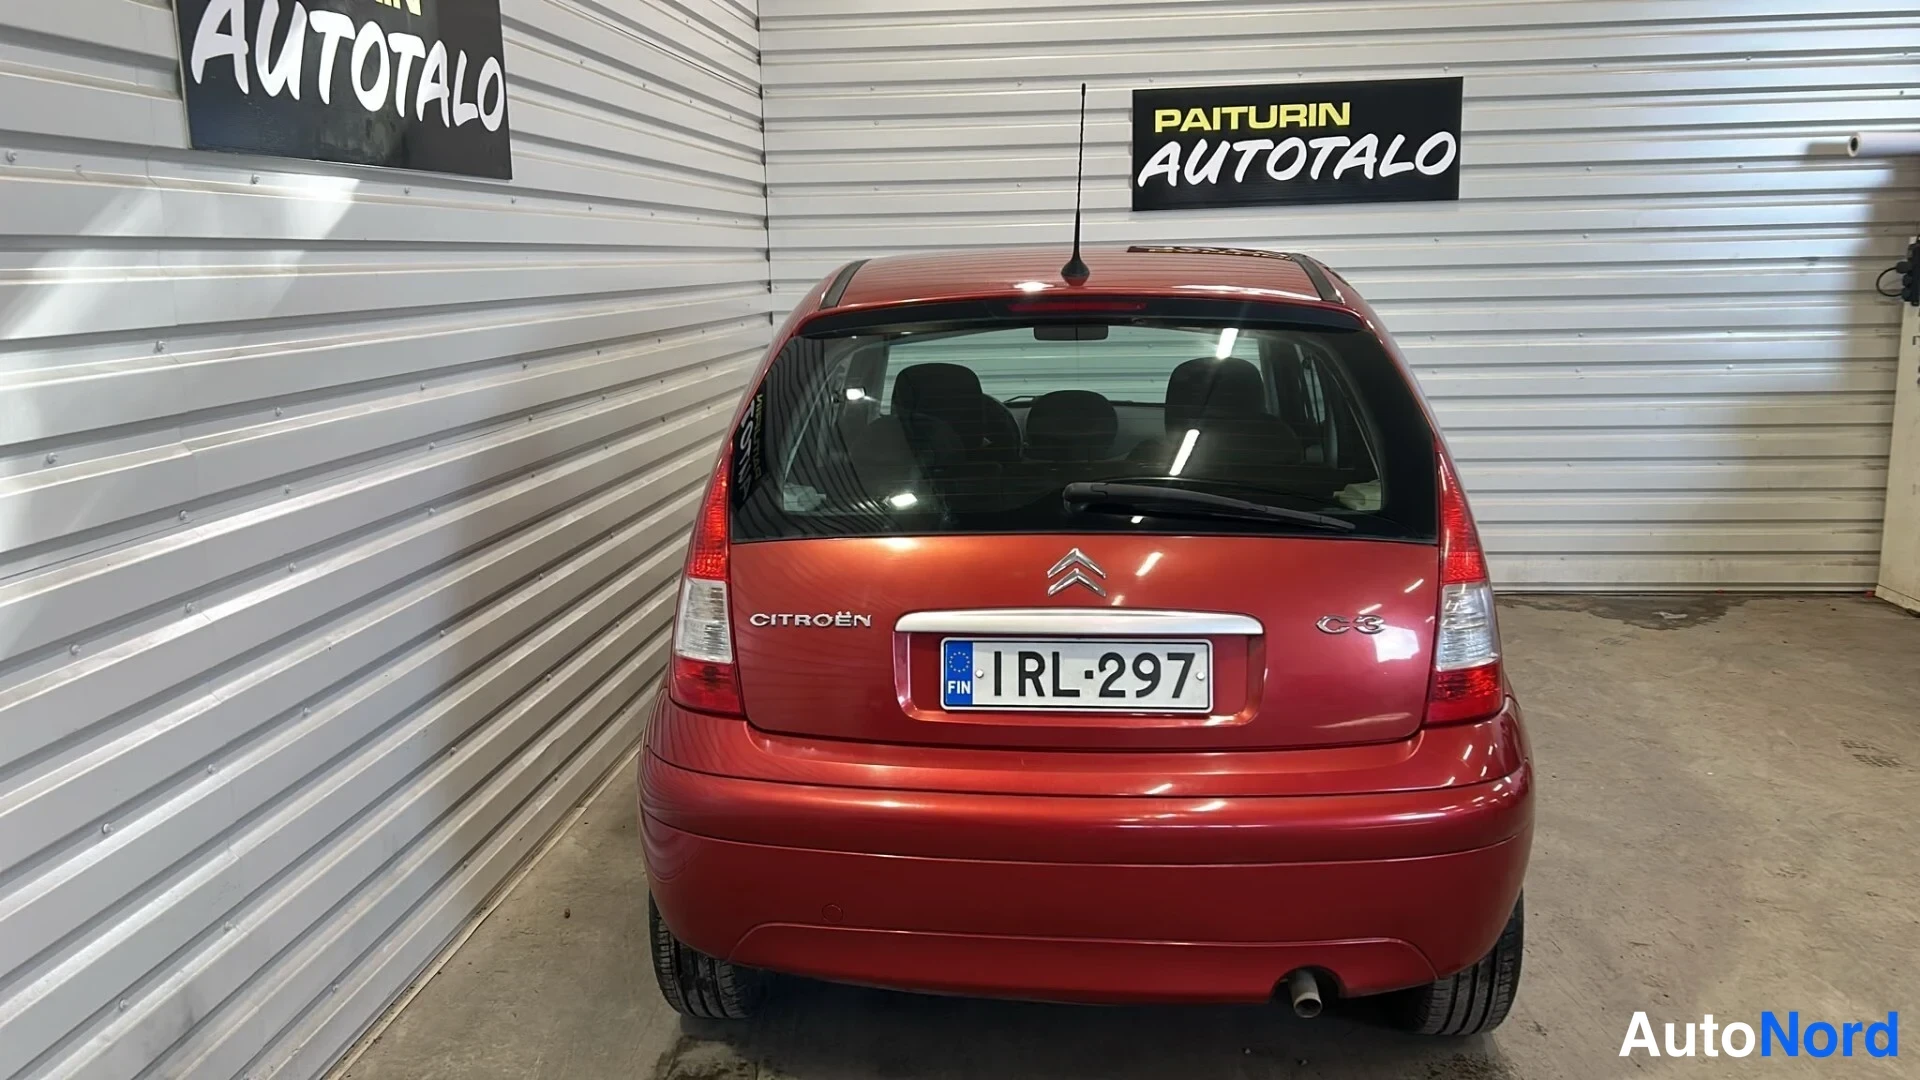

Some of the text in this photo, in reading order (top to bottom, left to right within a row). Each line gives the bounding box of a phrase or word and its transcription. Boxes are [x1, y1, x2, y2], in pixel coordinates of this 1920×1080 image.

[191, 0, 504, 132] AUTOTALO
[1154, 102, 1351, 133] PAITURIN
[1137, 131, 1457, 188] AUTOTALO
[749, 611, 872, 627] CITROËN
[1315, 614, 1386, 635] C3
[947, 680, 971, 695] FIN
